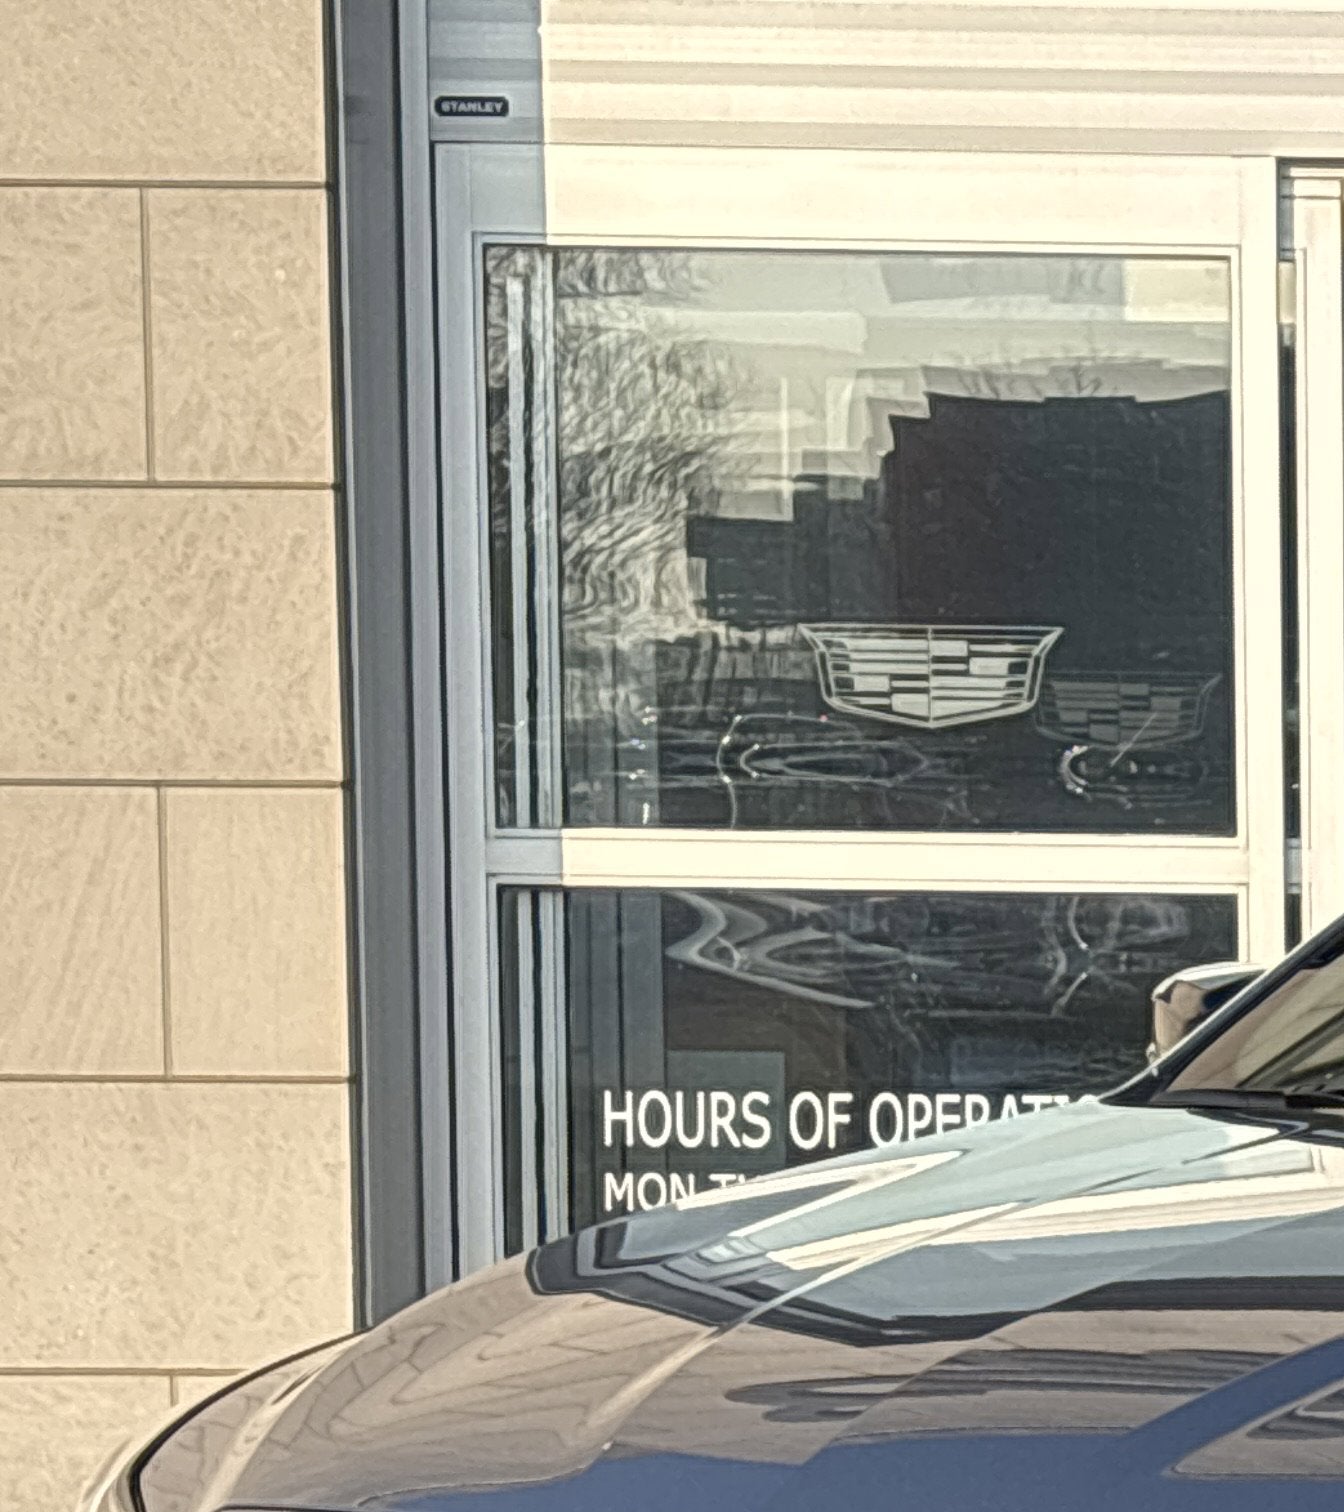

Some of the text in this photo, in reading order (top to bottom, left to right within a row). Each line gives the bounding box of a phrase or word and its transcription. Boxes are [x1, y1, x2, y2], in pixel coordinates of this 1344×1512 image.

[440, 100, 504, 113] STANLEY
[603, 1089, 772, 1149] HOURS
[788, 1090, 854, 1150] OF
